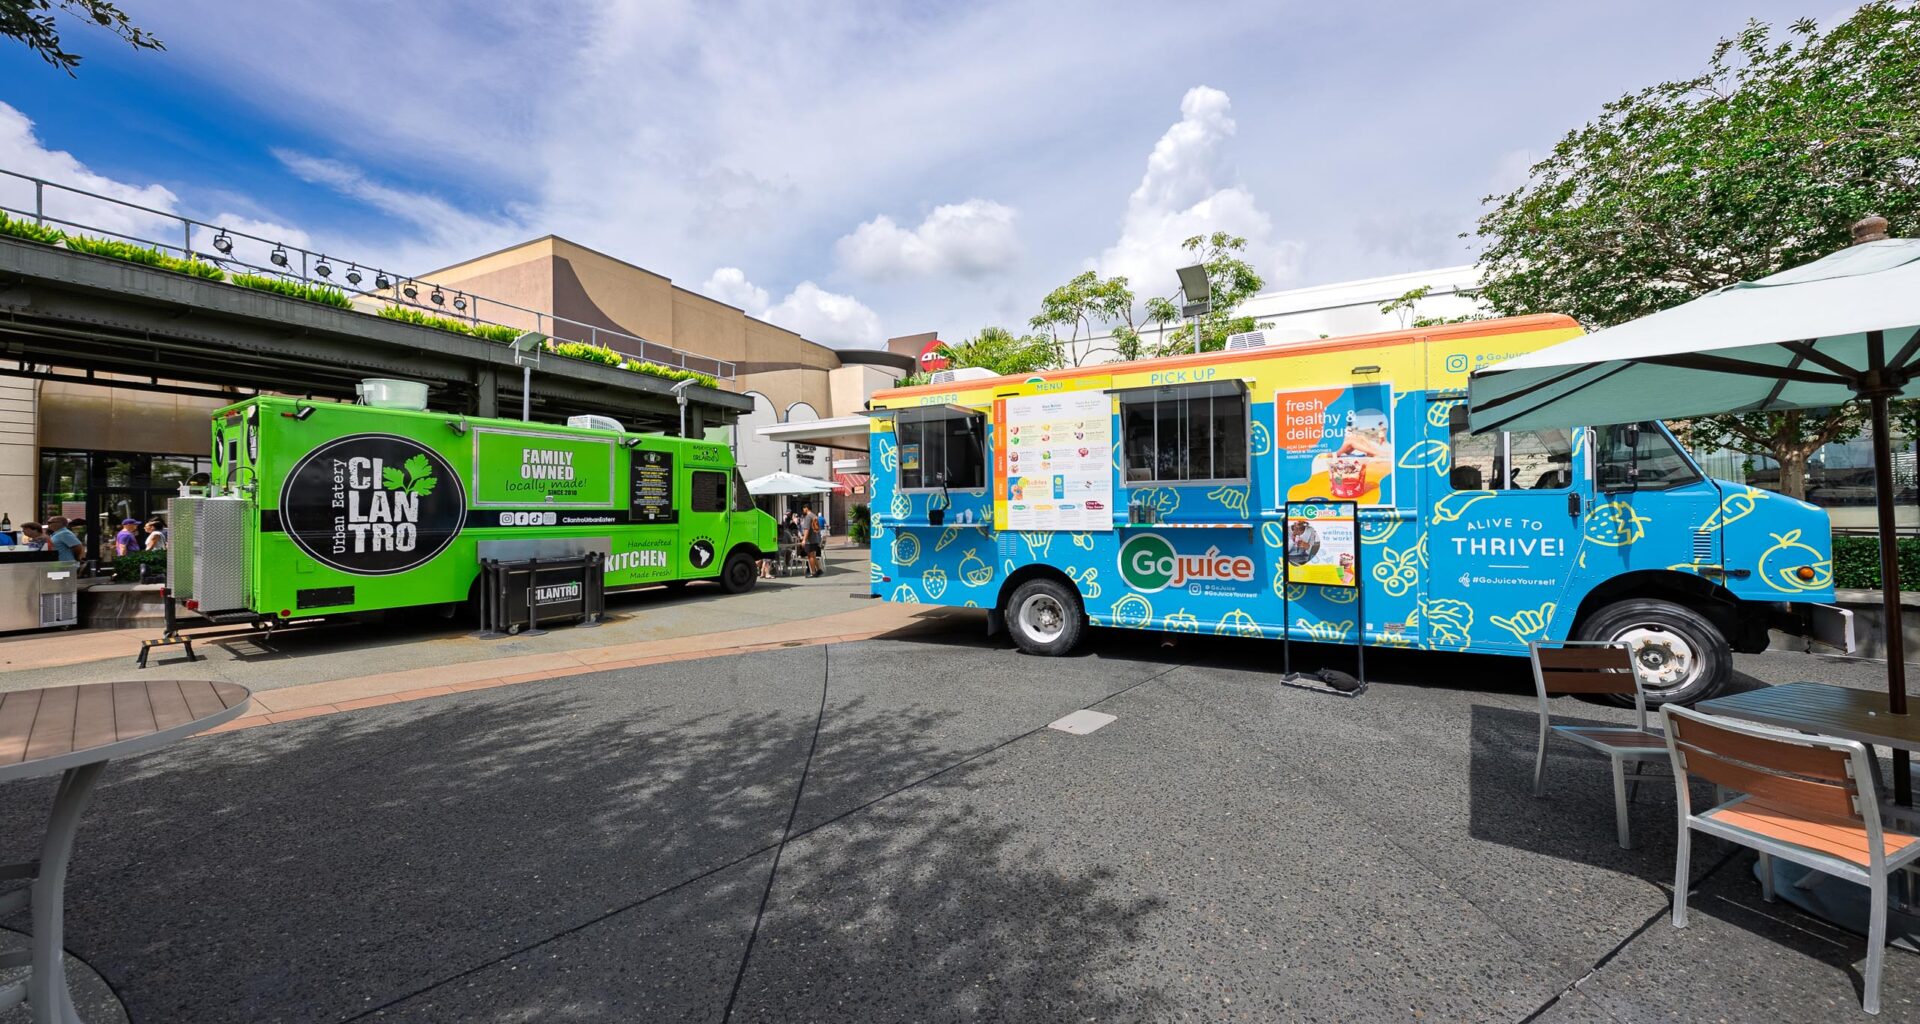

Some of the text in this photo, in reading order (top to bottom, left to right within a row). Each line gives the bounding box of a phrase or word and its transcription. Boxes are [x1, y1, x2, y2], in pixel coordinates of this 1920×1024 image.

[1152, 368, 1216, 386] PICK UP
[1036, 382, 1064, 391] MENU
[920, 394, 958, 407] ORDER
[1286, 410, 1356, 427] healthy &
[1286, 427, 1353, 440] delicious
[523, 448, 573, 465] FAMILY
[348, 456, 383, 490] CI
[521, 463, 574, 480] OWNED
[505, 478, 587, 493] locally made!
[332, 459, 347, 554] Urban Eatery
[348, 490, 419, 523] LAN
[1467, 518, 1543, 531] ALIVE TO
[347, 522, 417, 553] TRO
[627, 538, 672, 548] Handcrafted
[1451, 537, 1564, 557] THRIVE!
[604, 549, 667, 573] KITCHEN
[629, 571, 649, 579] Made
[1472, 576, 1556, 586] #GoJuiceYourself
[535, 585, 578, 600] ILANTRO
